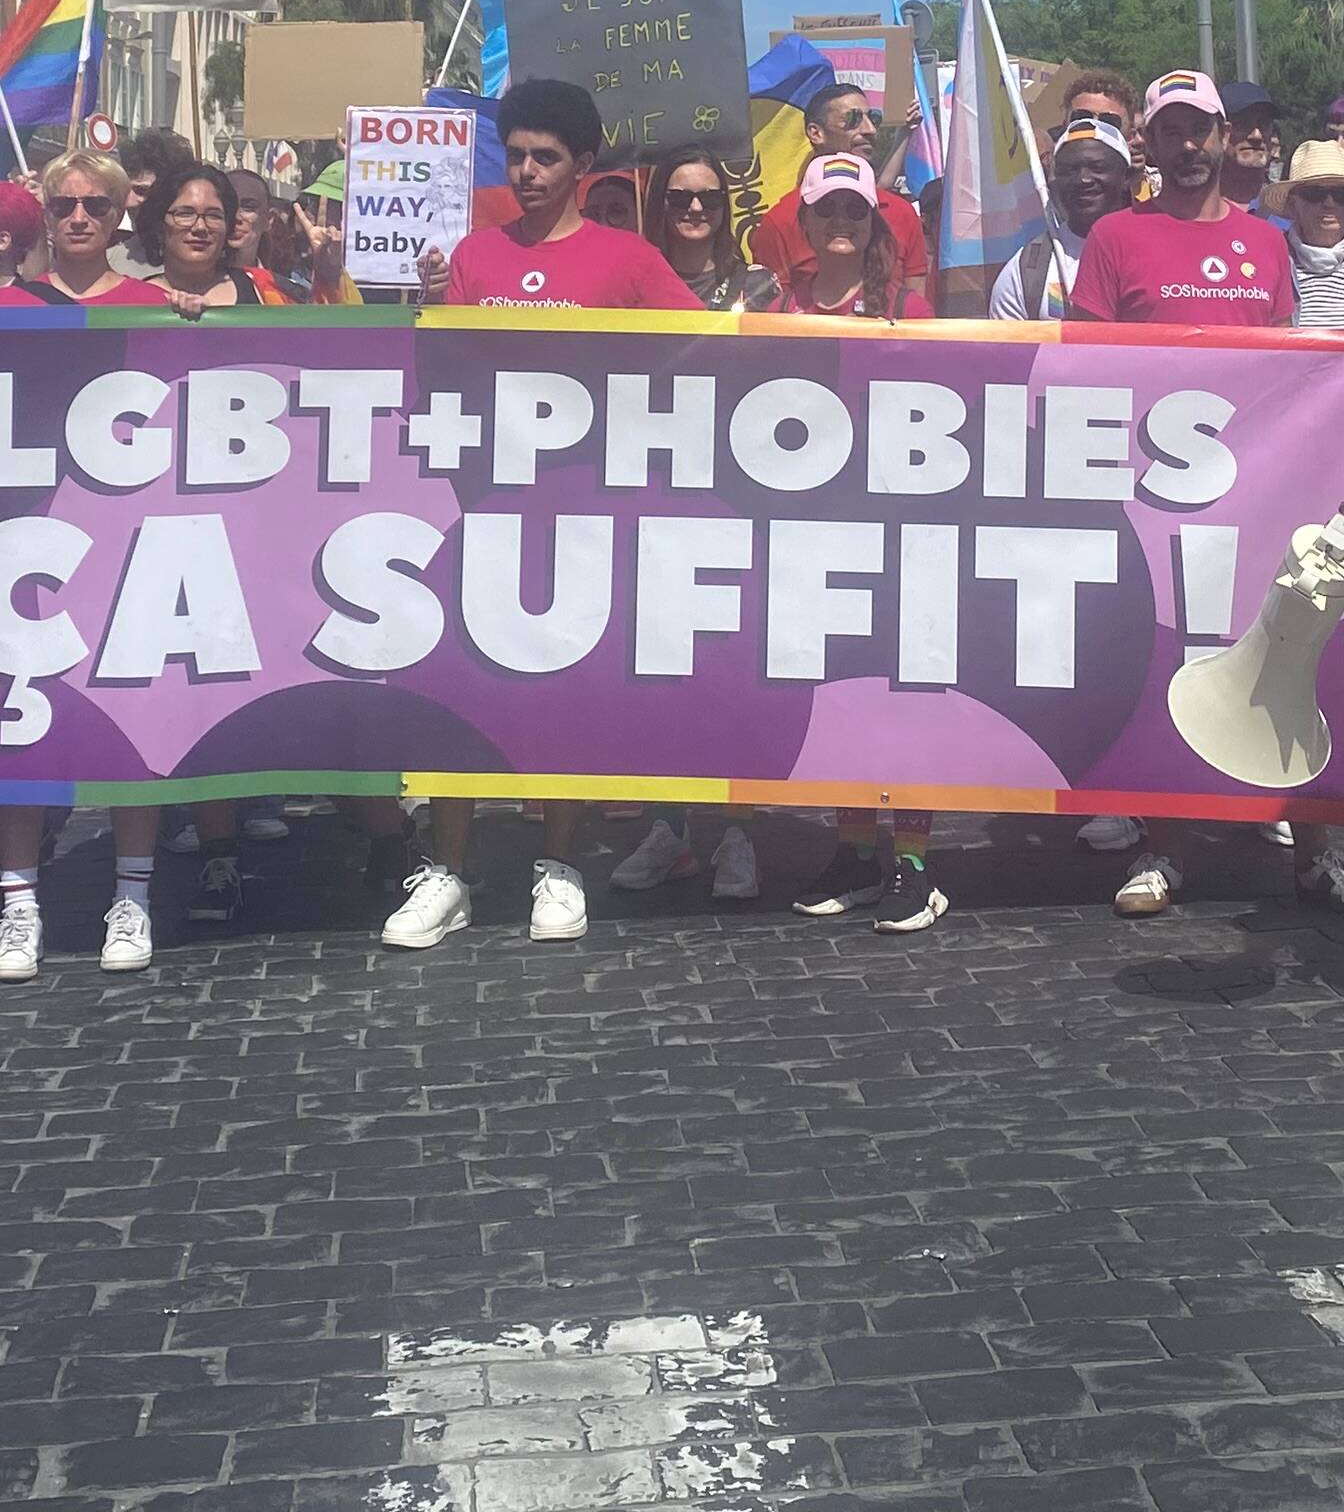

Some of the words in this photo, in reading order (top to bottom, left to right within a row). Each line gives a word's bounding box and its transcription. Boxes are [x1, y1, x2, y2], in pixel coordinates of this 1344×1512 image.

[556, 38, 581, 53] LA
[605, 13, 692, 50] FEMME
[594, 71, 622, 92] DE
[642, 59, 684, 82] MA
[360, 117, 467, 146] BORN
[601, 111, 665, 148] VIE
[357, 160, 431, 182] THIS
[356, 195, 433, 223] WAY,
[354, 230, 426, 258] baby
[311, 511, 1119, 689] SUFFIT
[1179, 524, 1240, 664] !
